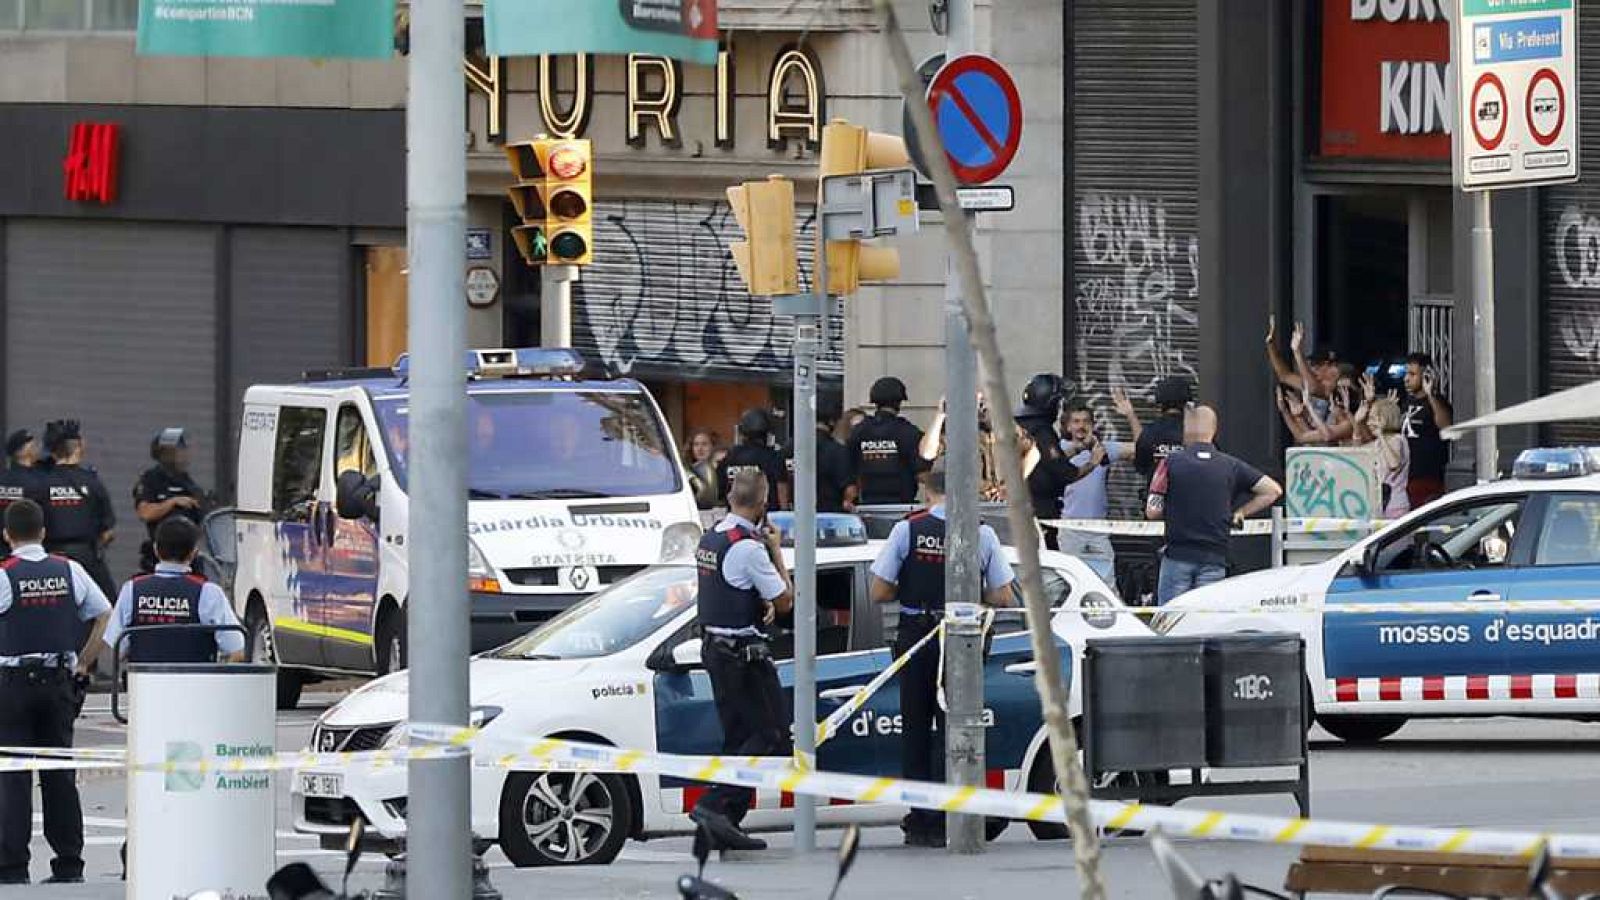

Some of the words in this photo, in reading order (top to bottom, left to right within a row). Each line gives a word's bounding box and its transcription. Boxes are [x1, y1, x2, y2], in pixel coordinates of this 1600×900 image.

[861, 440, 897, 450] POLICIA
[571, 514, 663, 529] Urbana
[19, 577, 68, 591] POLICIA
[138, 596, 190, 609] POLICIA
[1380, 625, 1470, 643] mossos
